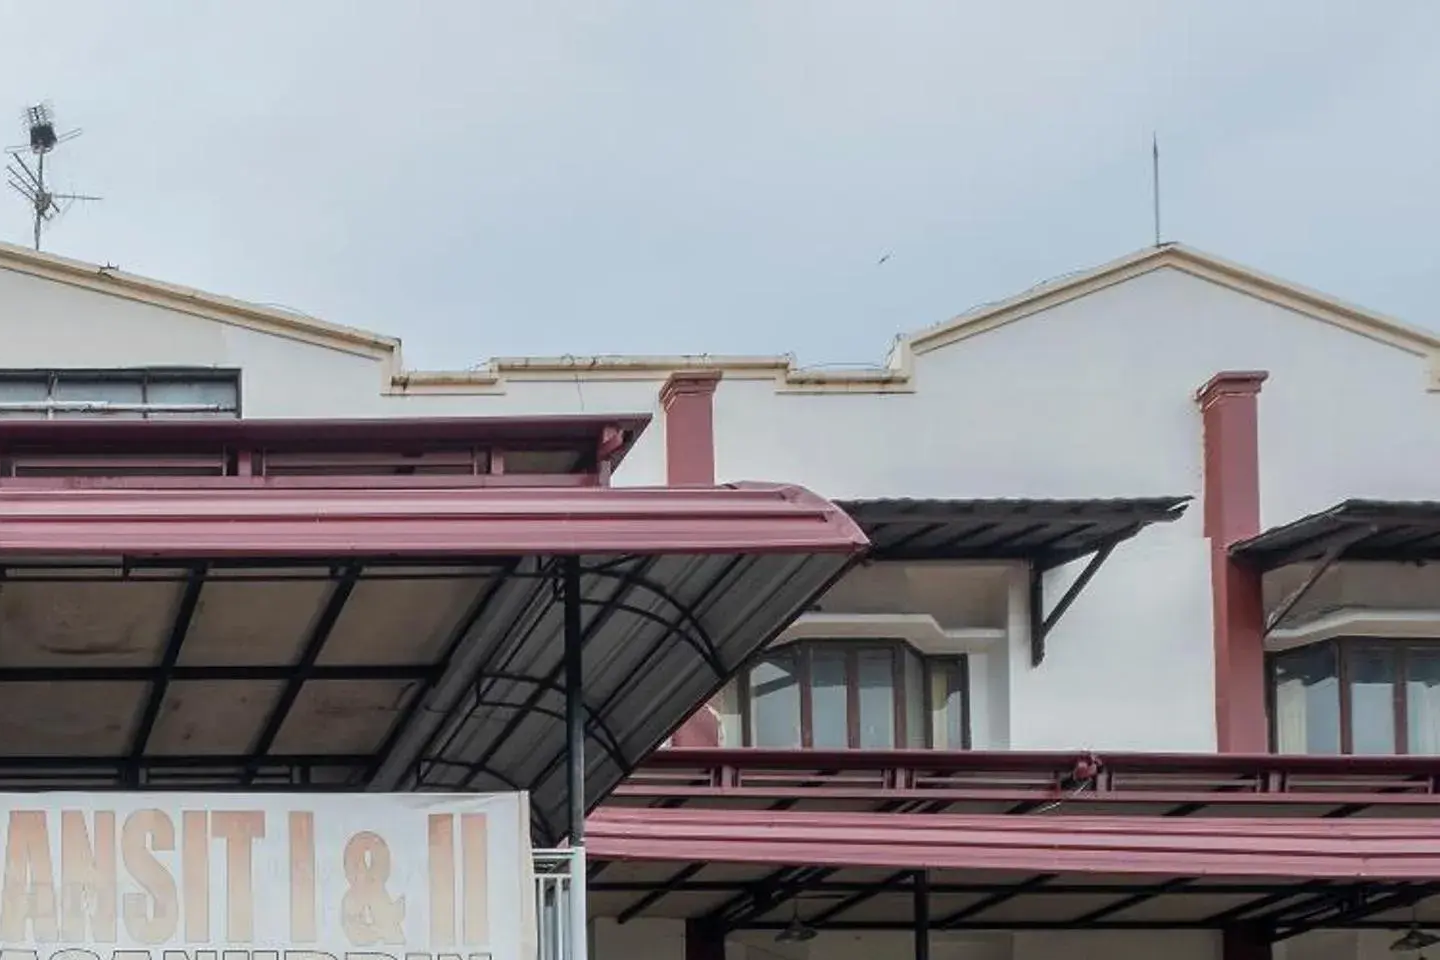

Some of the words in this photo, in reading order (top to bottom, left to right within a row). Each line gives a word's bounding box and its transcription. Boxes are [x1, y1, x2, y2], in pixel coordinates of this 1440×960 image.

[288, 810, 318, 944] I
[341, 830, 406, 947] &
[428, 813, 489, 946] II
